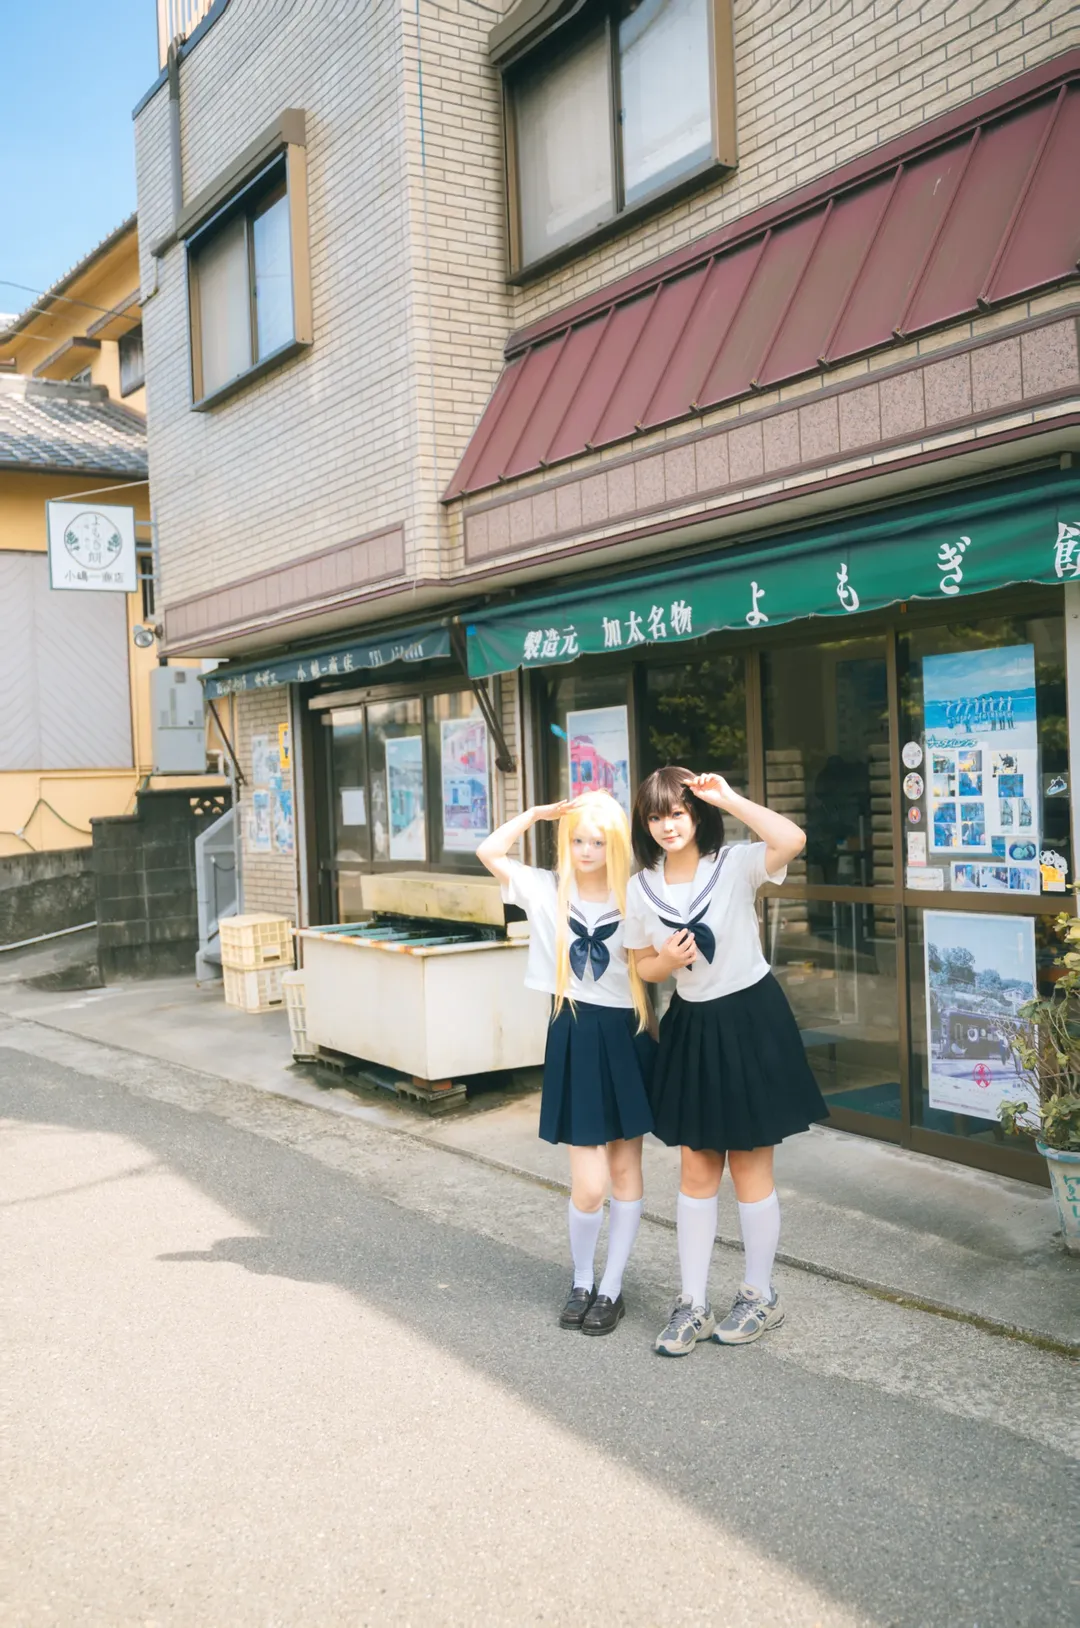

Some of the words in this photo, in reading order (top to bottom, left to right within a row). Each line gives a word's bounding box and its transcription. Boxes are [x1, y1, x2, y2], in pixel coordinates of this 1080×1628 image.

[523, 625, 578, 660] 製造元
[602, 600, 692, 648] 加太名物
